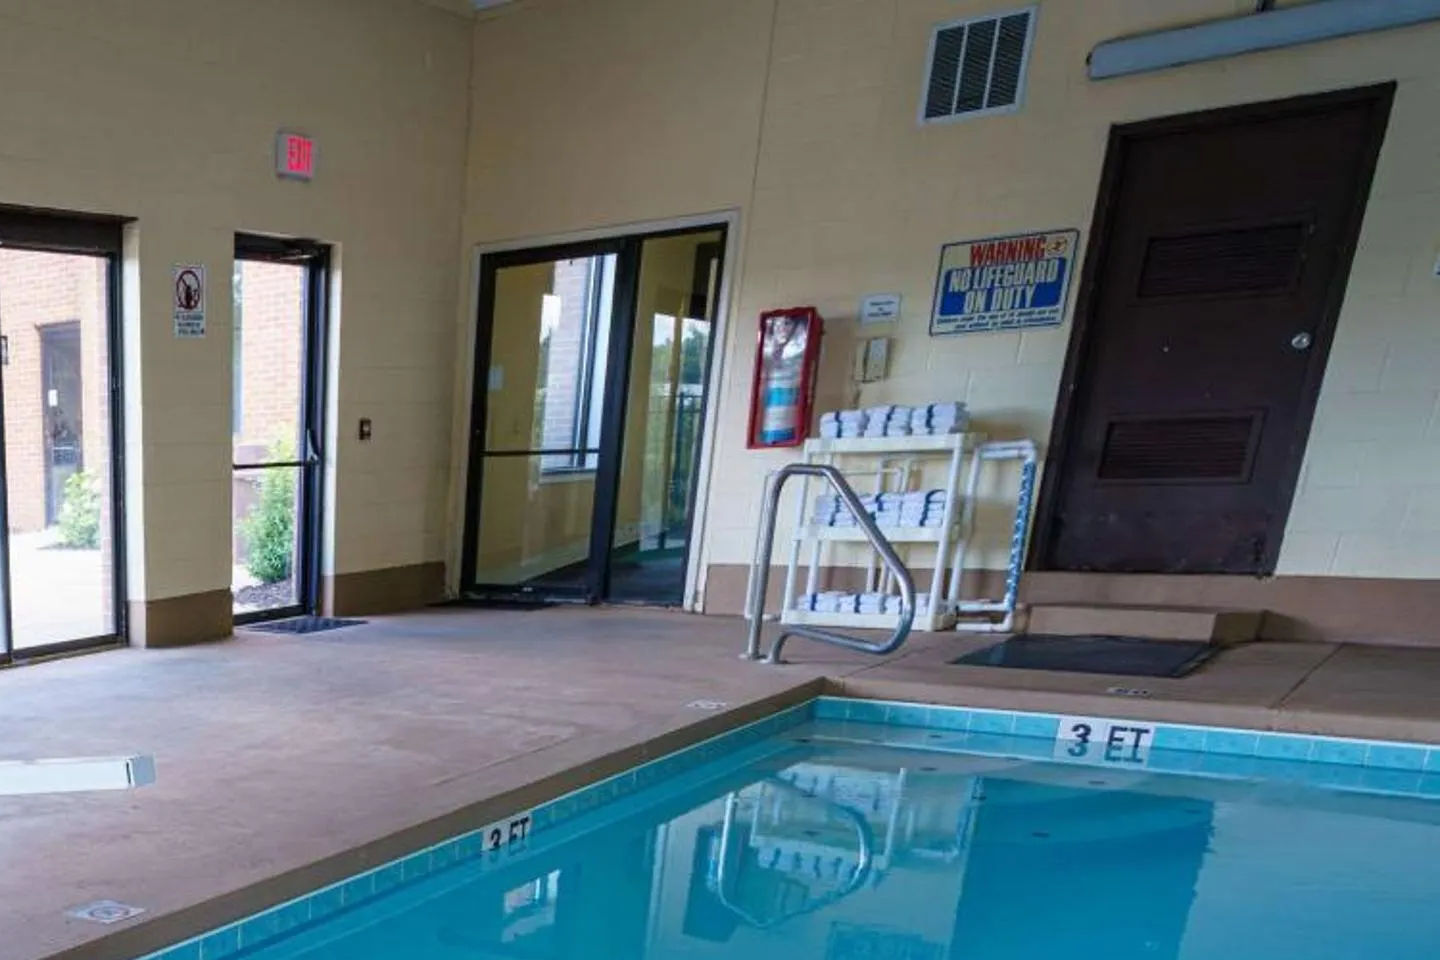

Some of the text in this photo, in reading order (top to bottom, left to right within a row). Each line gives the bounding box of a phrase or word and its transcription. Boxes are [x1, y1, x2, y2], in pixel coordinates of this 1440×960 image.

[287, 137, 312, 175] EXIT
[970, 237, 1046, 267] WARNING
[949, 258, 1059, 293] NO LIFEGUARD
[963, 289, 988, 316] ON
[991, 284, 1037, 313] DUTY
[509, 816, 529, 845] FT
